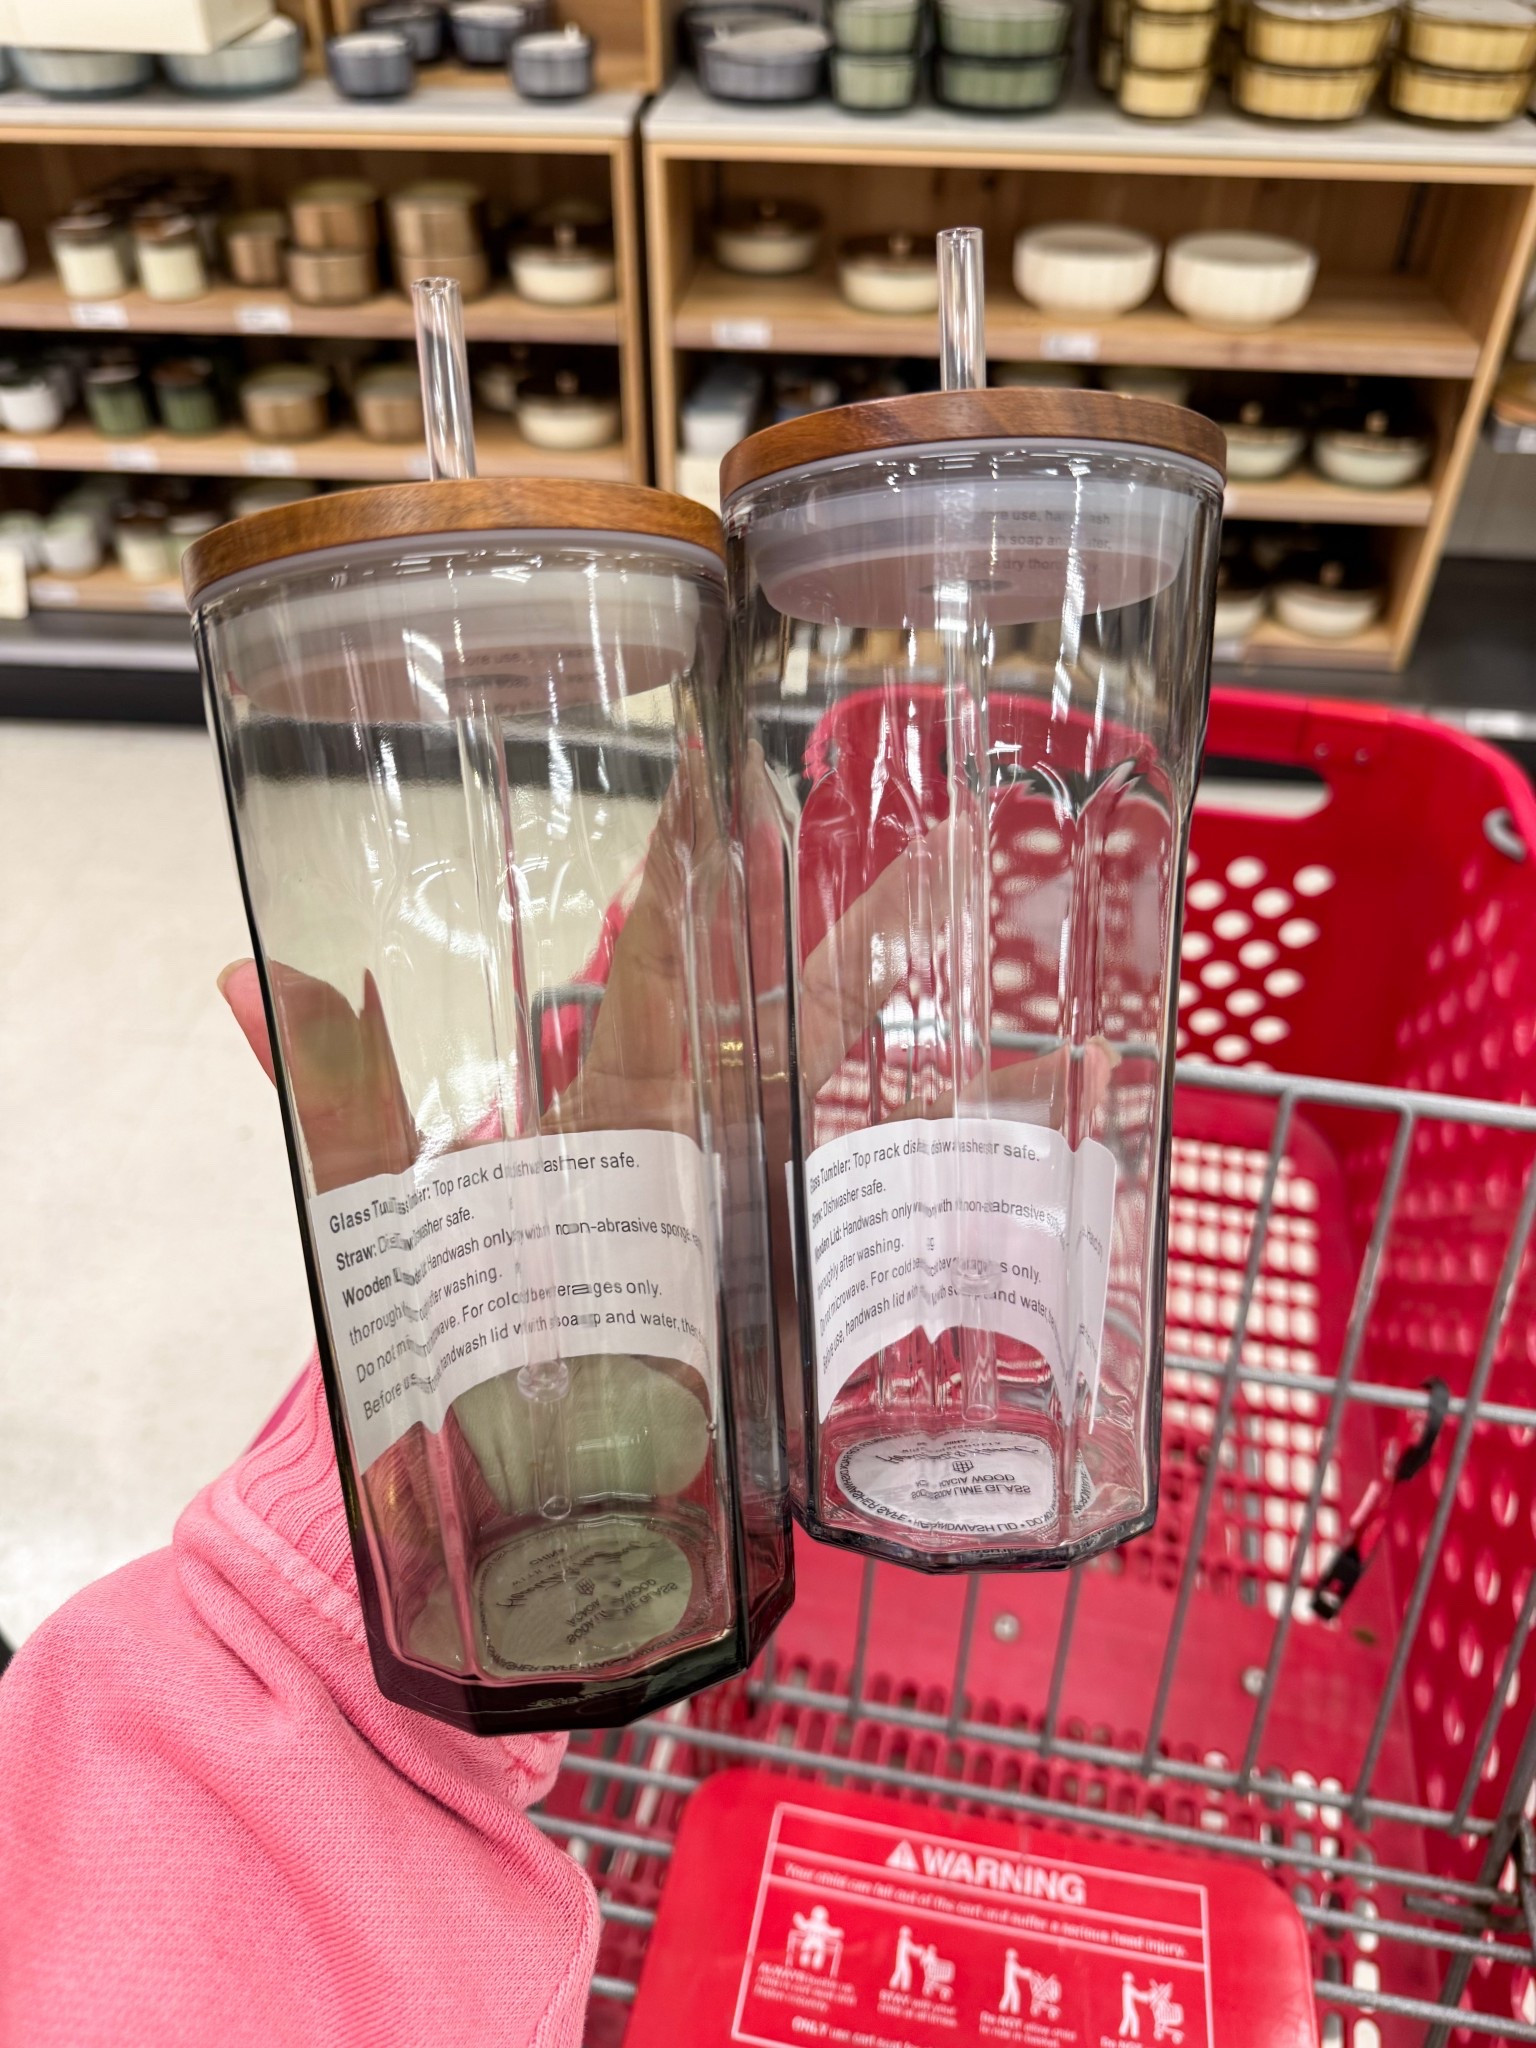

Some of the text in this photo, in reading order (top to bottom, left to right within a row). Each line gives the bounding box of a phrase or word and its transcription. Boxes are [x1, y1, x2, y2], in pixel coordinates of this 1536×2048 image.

[1010, 535, 1043, 547] soap
[1045, 509, 1110, 525] haash
[820, 1158, 851, 1183] Tumbler:
[853, 1152, 870, 1169] Top
[873, 1143, 900, 1162] rack
[1003, 1144, 1040, 1161] safe.
[329, 1208, 371, 1234] Glass
[371, 1187, 430, 1218] Tuer:
[432, 1180, 454, 1197] Top
[457, 1167, 489, 1189] rack
[600, 1152, 639, 1169] safe.
[822, 1188, 859, 1217] Dishwasher
[861, 1178, 886, 1198] safe.
[336, 1243, 377, 1271] Straw:
[446, 1207, 475, 1228] safe.
[829, 1225, 842, 1247] Lid:
[842, 1207, 889, 1238] Handwash
[891, 1201, 912, 1219] only
[342, 1274, 392, 1308] Wooden
[483, 1228, 513, 1249] only
[840, 1252, 855, 1273] after
[857, 1237, 904, 1261] washing.
[349, 1301, 419, 1346] thorough
[444, 1267, 503, 1297] washing.
[830, 1279, 868, 1316] microwave.
[870, 1270, 889, 1287] For
[892, 1257, 912, 1278] cold
[1012, 1264, 1041, 1284] only.
[845, 1298, 890, 1337] handwash
[893, 1289, 905, 1307] lid
[356, 1364, 375, 1383] Do
[377, 1347, 397, 1370] not
[462, 1303, 484, 1322] For
[626, 1279, 662, 1298] only.
[363, 1387, 402, 1420] Before
[491, 1323, 509, 1342] lid
[605, 1310, 635, 1325] and
[640, 1312, 680, 1332] water,
[921, 1843, 1087, 1906] WARNING
